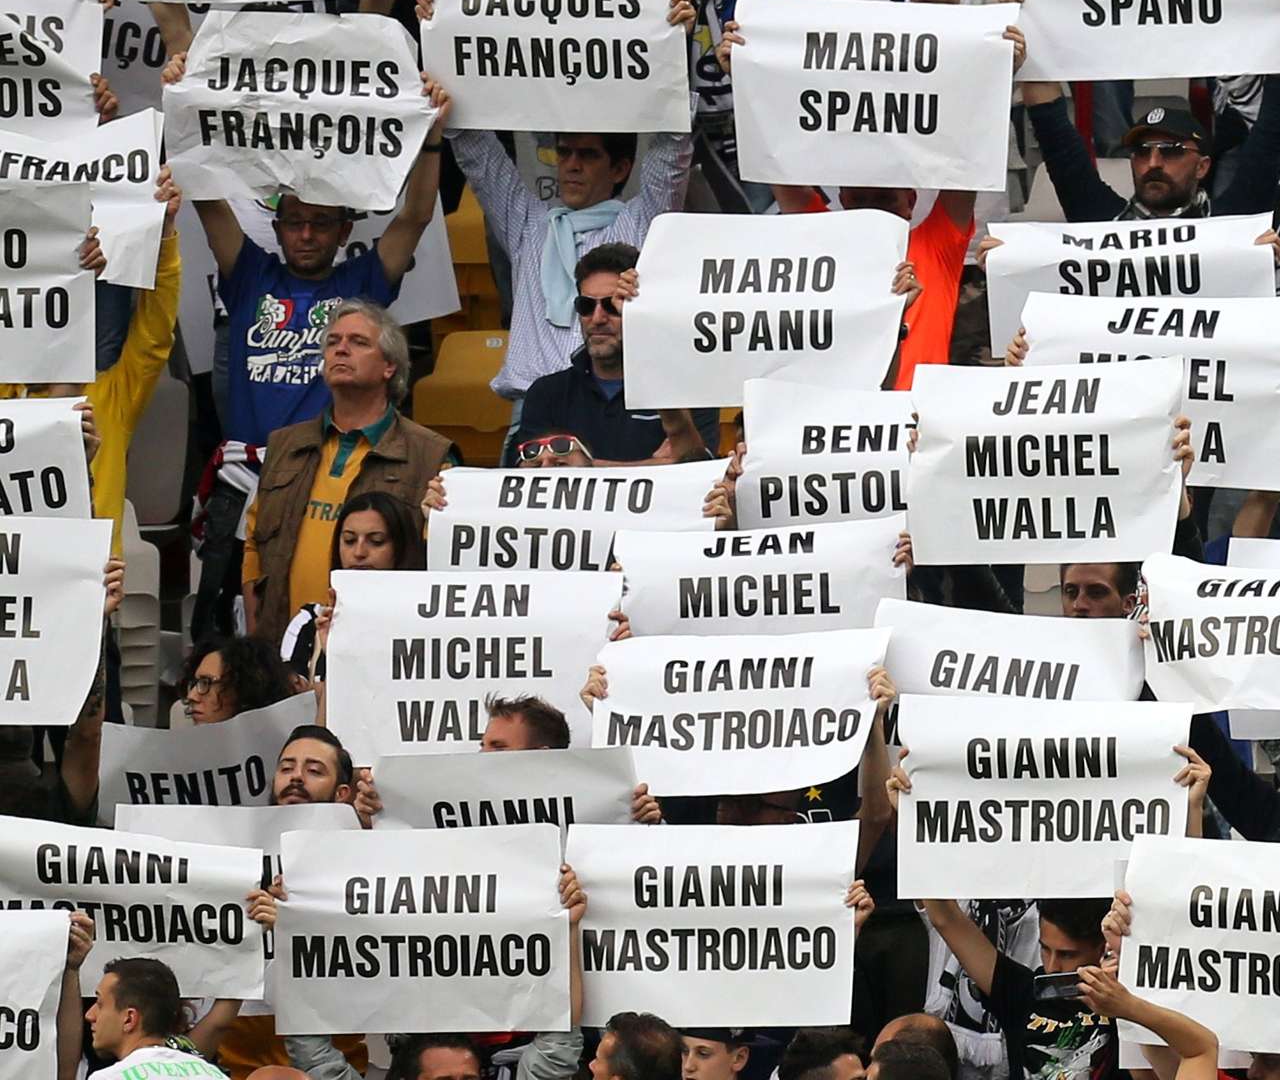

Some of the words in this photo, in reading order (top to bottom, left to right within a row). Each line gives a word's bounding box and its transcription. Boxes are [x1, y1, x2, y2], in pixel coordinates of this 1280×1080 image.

[453, 35, 650, 86] FRANÇOIS
[803, 32, 938, 74] MARIO
[207, 55, 400, 100] JACQUES
[197, 108, 404, 160] FRANÇOIS
[0, 149, 149, 184] FRANCO
[699, 255, 836, 294] MARIO
[1058, 253, 1201, 298] SPANU
[992, 377, 1101, 416] JEAN
[498, 475, 654, 514] BENITO
[972, 496, 1116, 541] WALLA
[417, 584, 530, 619] JEAN
[679, 572, 841, 619] MICHEL
[392, 636, 553, 680] MICHEL
[930, 649, 1080, 701] GIANNI
[966, 736, 1118, 780] GIANNI
[36, 843, 189, 885] GIANNI
[345, 874, 497, 916] GIANNI
[634, 864, 783, 909] GIANNI
[291, 933, 551, 979] MASTROIACO
[581, 925, 836, 972] MASTROIACO
